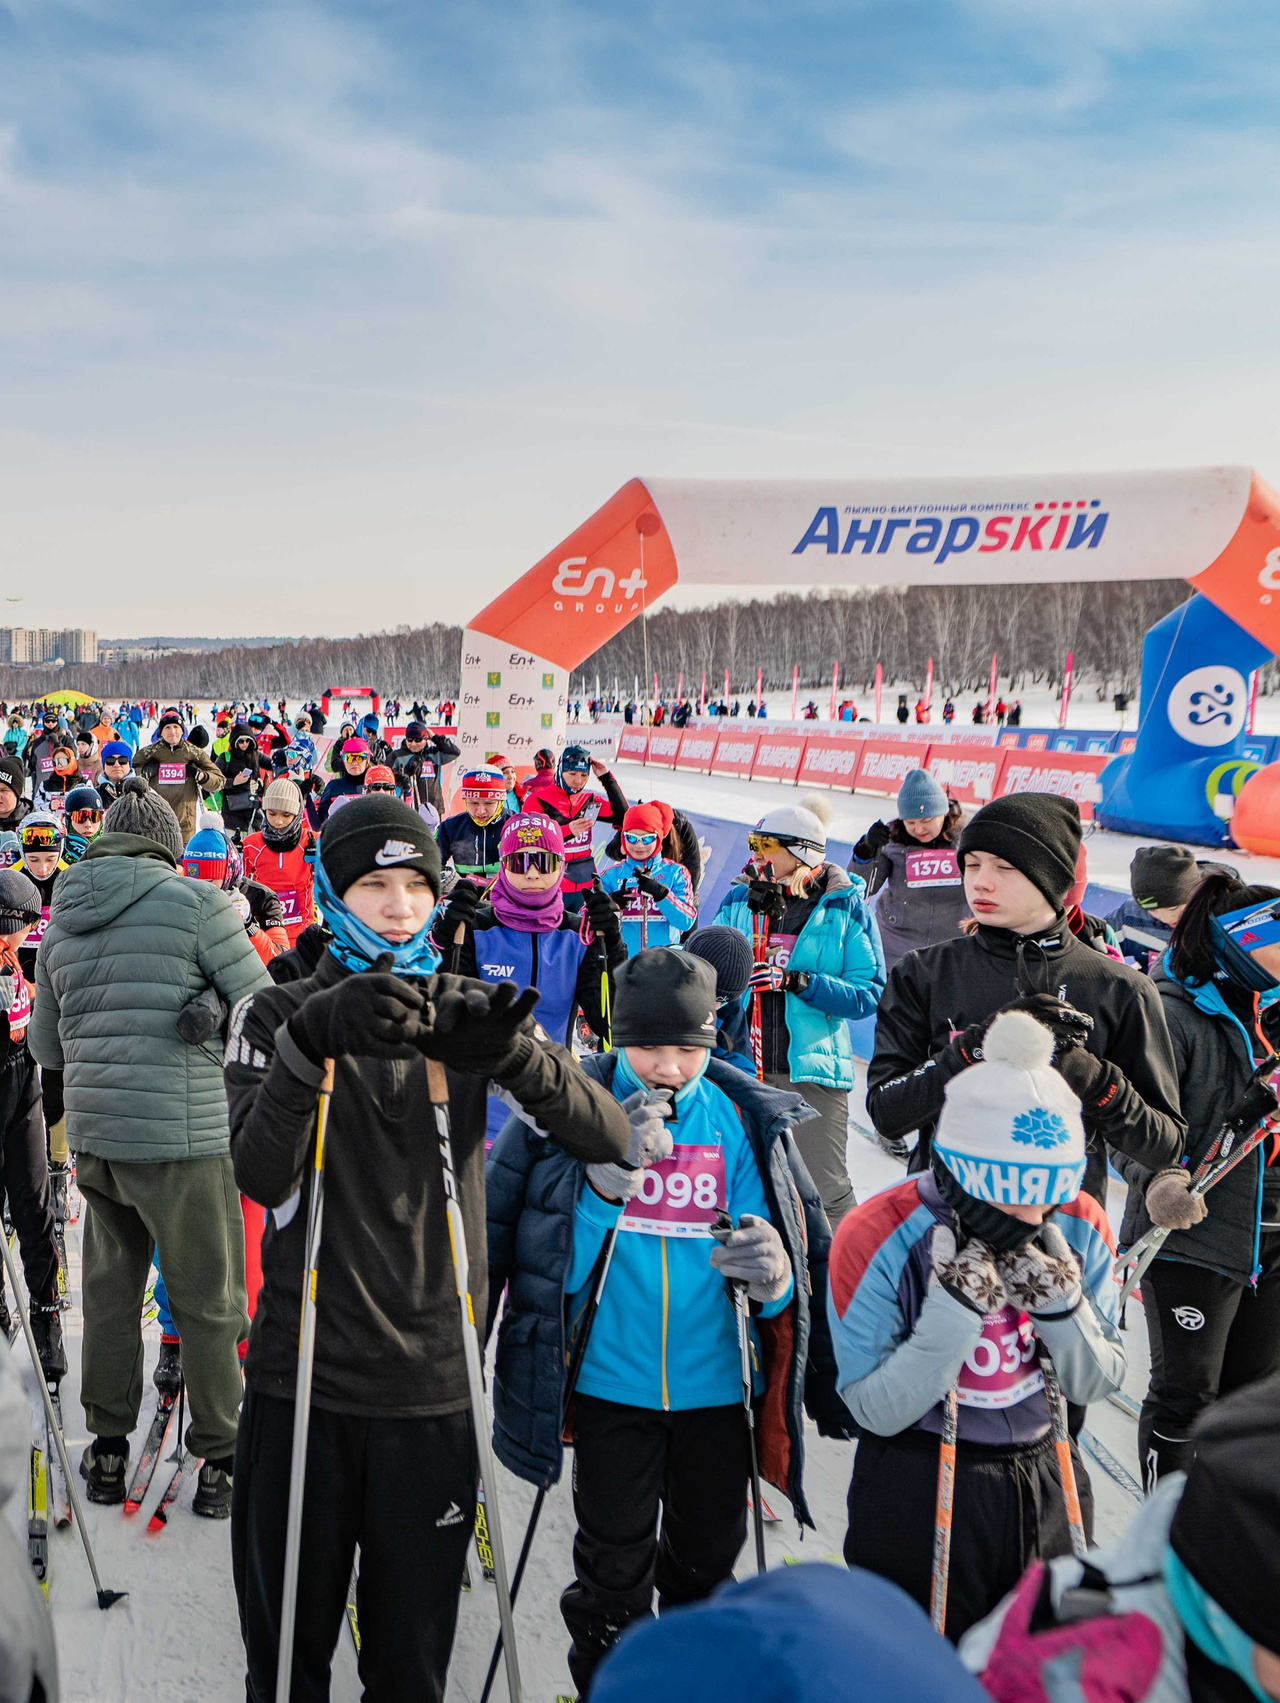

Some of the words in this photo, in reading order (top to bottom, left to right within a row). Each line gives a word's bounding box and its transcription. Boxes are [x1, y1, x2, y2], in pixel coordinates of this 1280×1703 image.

[554, 601, 638, 613] GROUP
[161, 769, 184, 778] 1394
[504, 817, 558, 839] RUSSIA
[911, 860, 953, 876] 1376
[481, 964, 516, 978] RAY
[624, 1167, 718, 1210] 098
